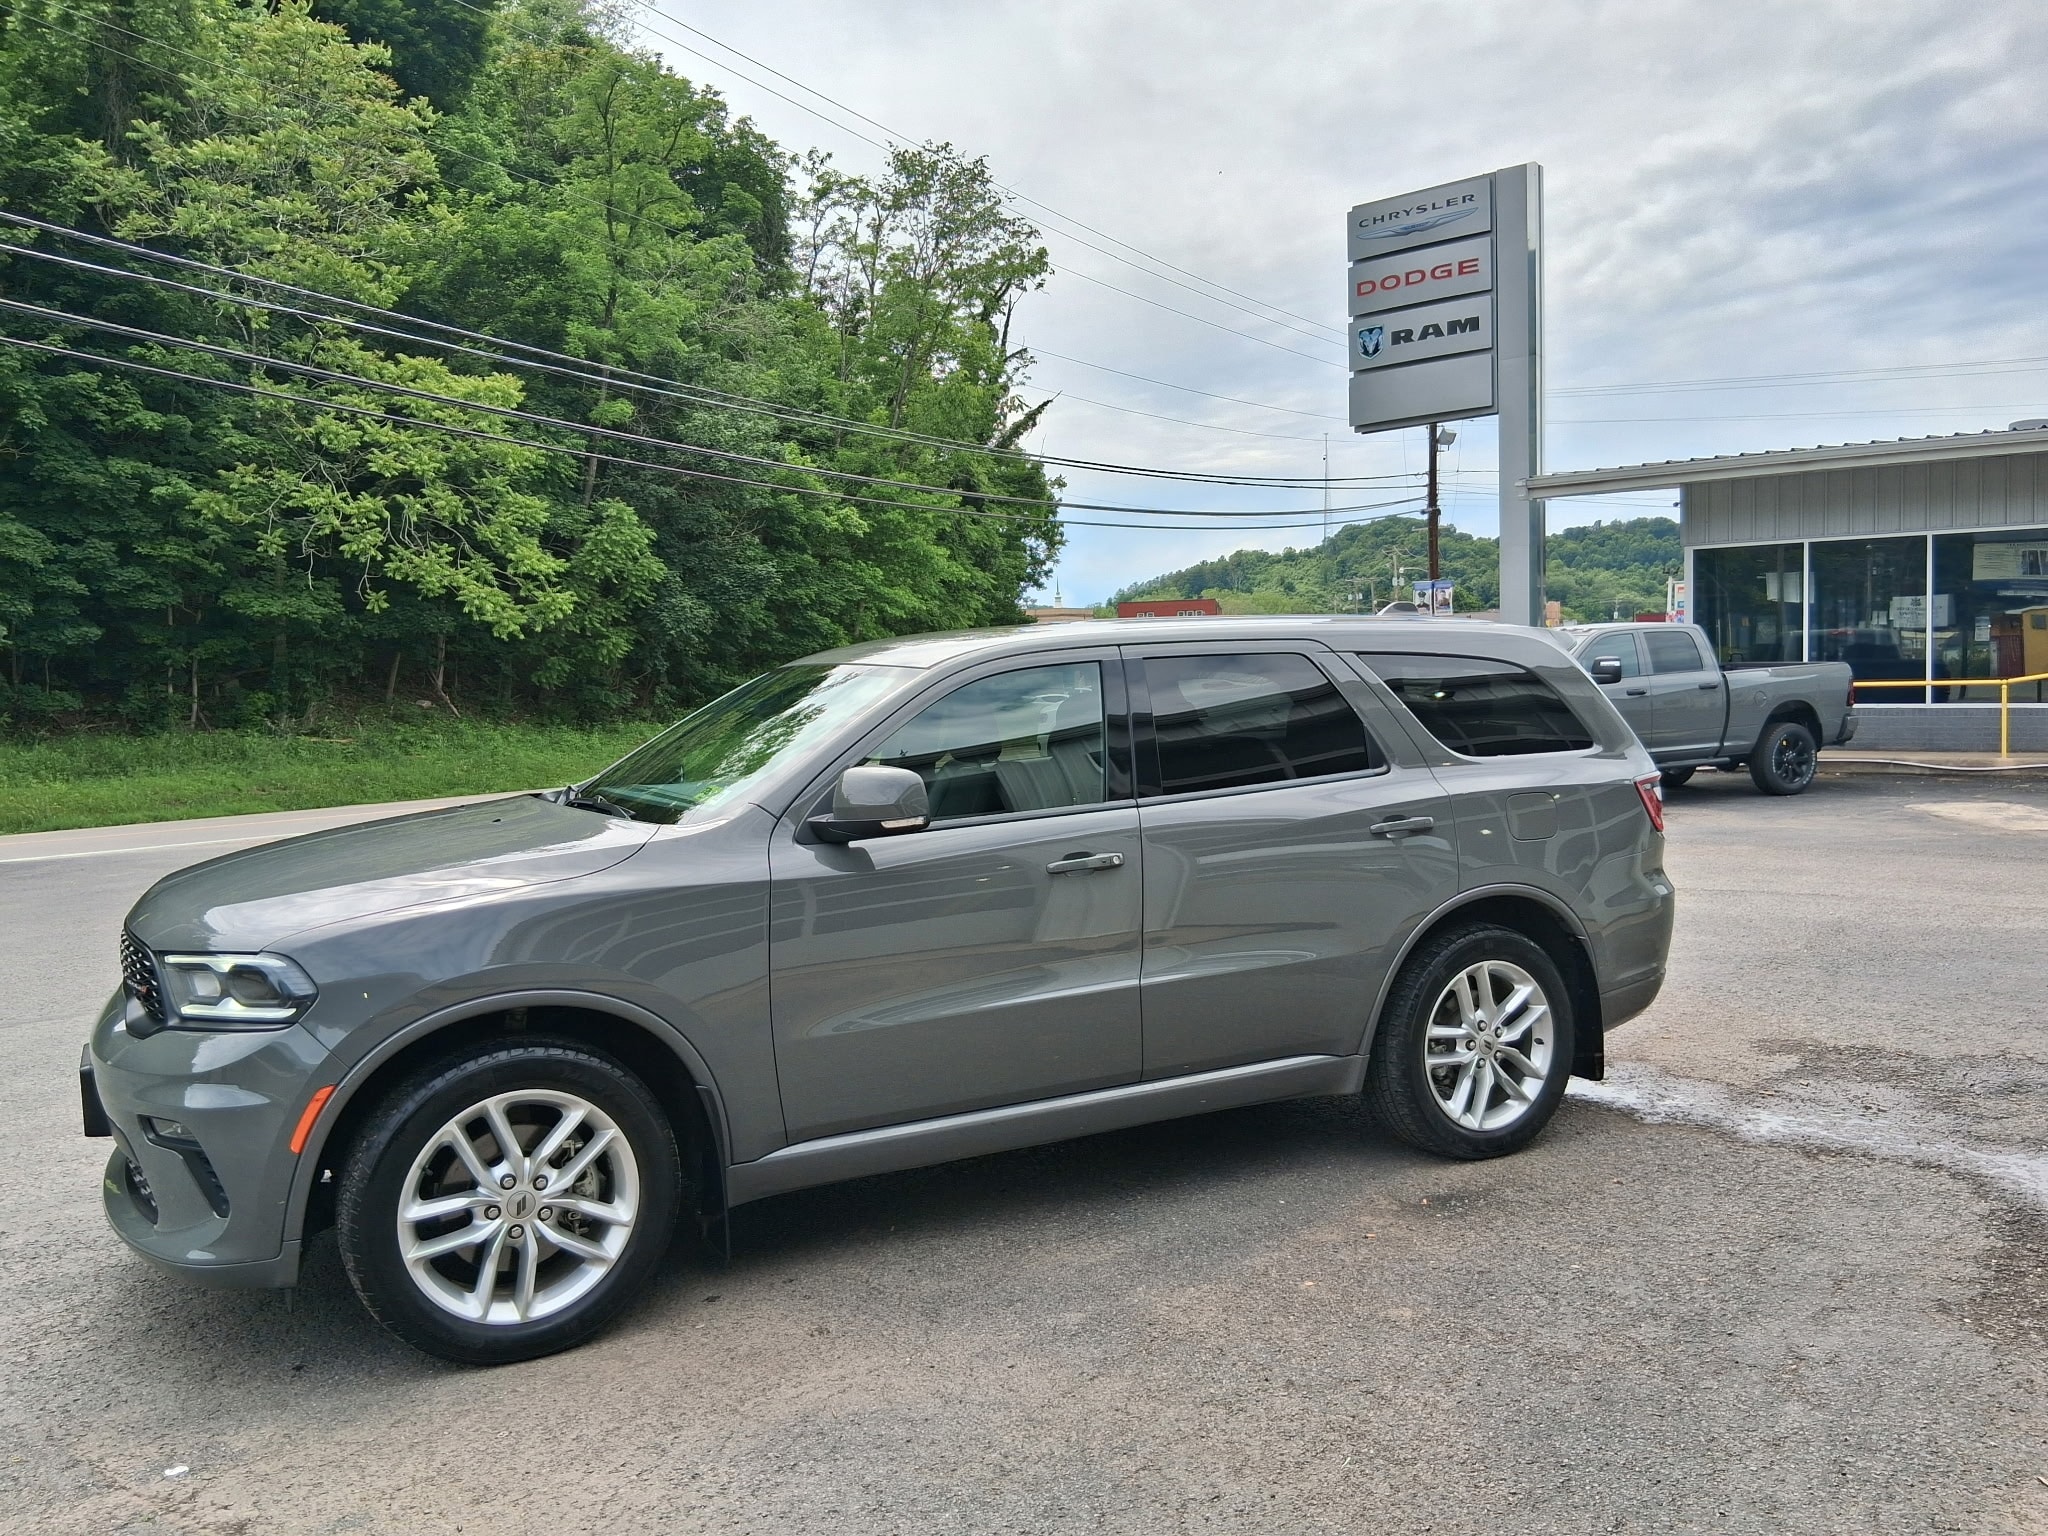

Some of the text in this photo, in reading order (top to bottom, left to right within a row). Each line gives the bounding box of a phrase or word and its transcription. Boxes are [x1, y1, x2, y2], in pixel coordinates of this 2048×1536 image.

[1358, 193, 1475, 228] CHRYSLER
[1356, 257, 1480, 297] DODGE
[1391, 315, 1480, 346] RAM
